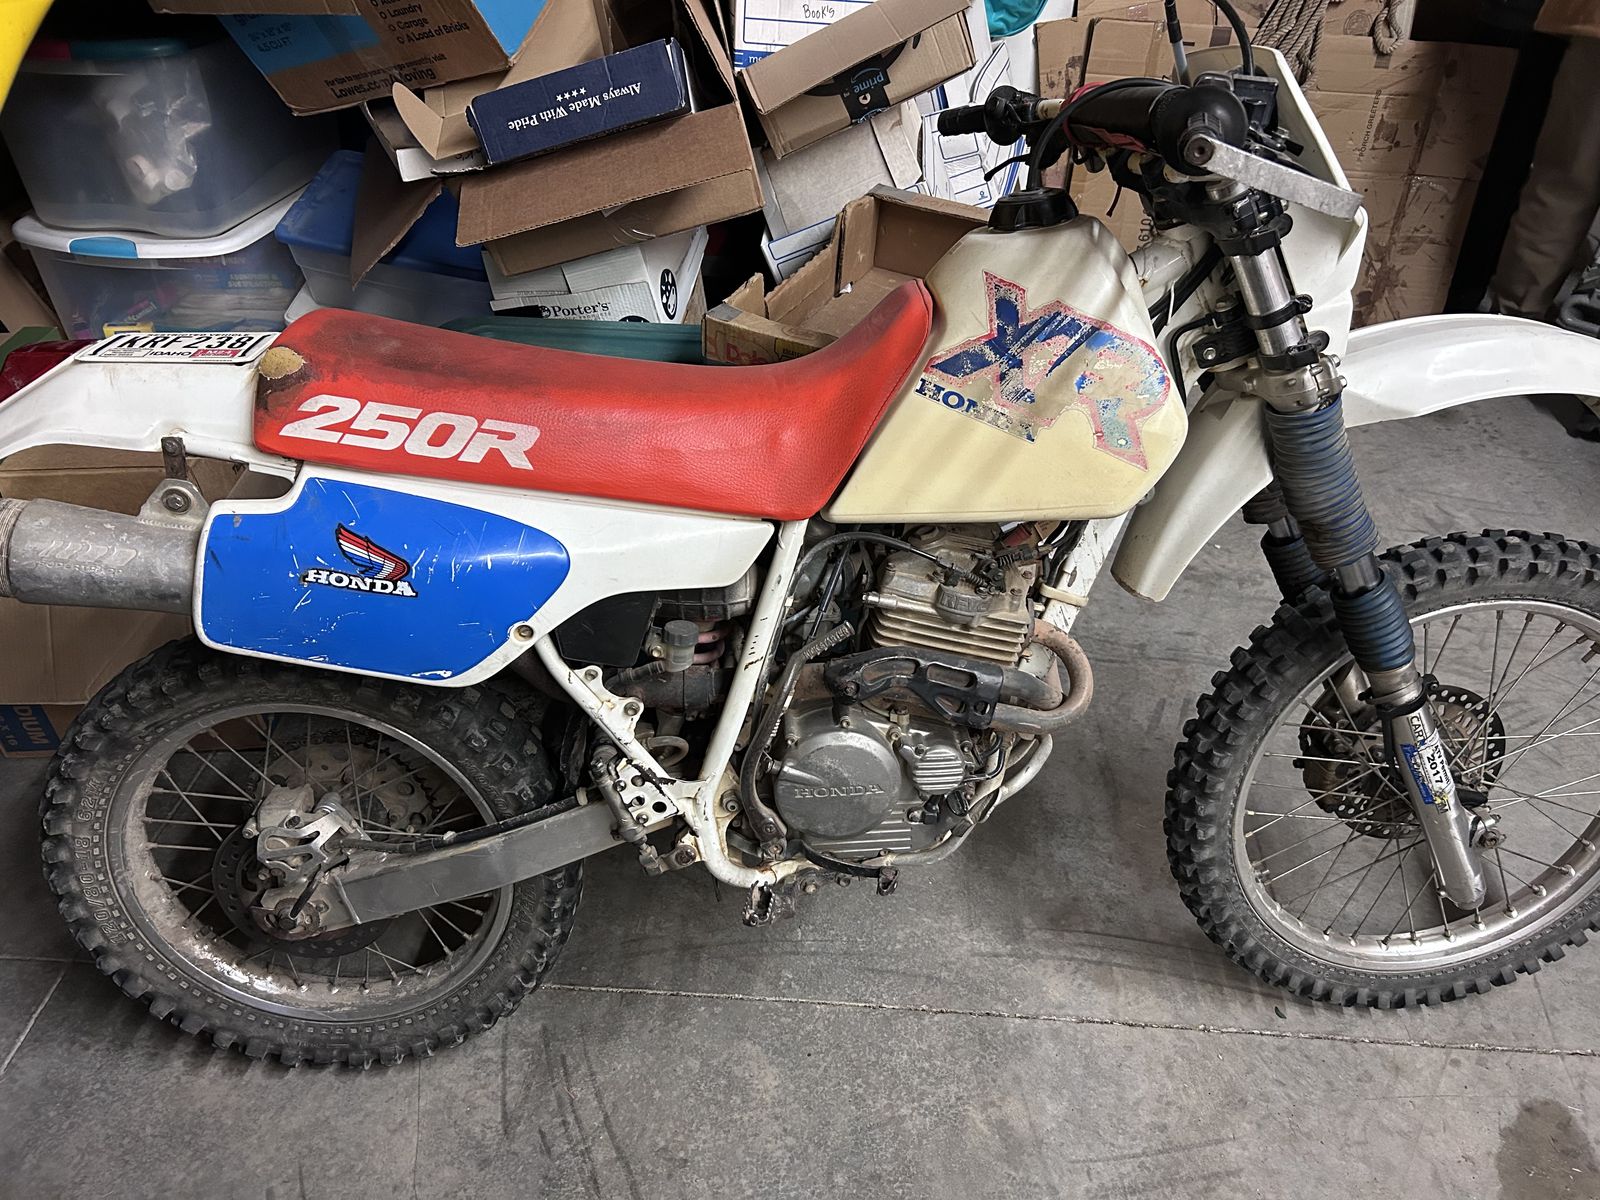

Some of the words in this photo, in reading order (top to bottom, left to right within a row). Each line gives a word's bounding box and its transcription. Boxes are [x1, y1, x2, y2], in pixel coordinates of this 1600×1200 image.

[389, 3, 423, 18] Laundry
[802, 4, 835, 19] Book's
[397, 17, 430, 30] Garage
[406, 31, 416, 42] A
[413, 26, 435, 41] Load
[435, 25, 444, 36] of
[443, 21, 470, 34] Bricks
[602, 82, 642, 101] Always
[852, 71, 884, 93] prime
[539, 105, 569, 122] With
[568, 94, 602, 113] Made
[507, 114, 540, 131] Pride
[1358, 125, 1372, 158] PORCH
[551, 301, 610, 317] Porter's
[278, 394, 540, 470] 250R
[302, 567, 417, 597] HONDA
[1426, 755, 1444, 784] 2017
[1439, 759, 1451, 784] Permit
[76, 777, 104, 822] 62M
[793, 782, 886, 799] HONDA
[73, 835, 129, 945] 120/80-18
